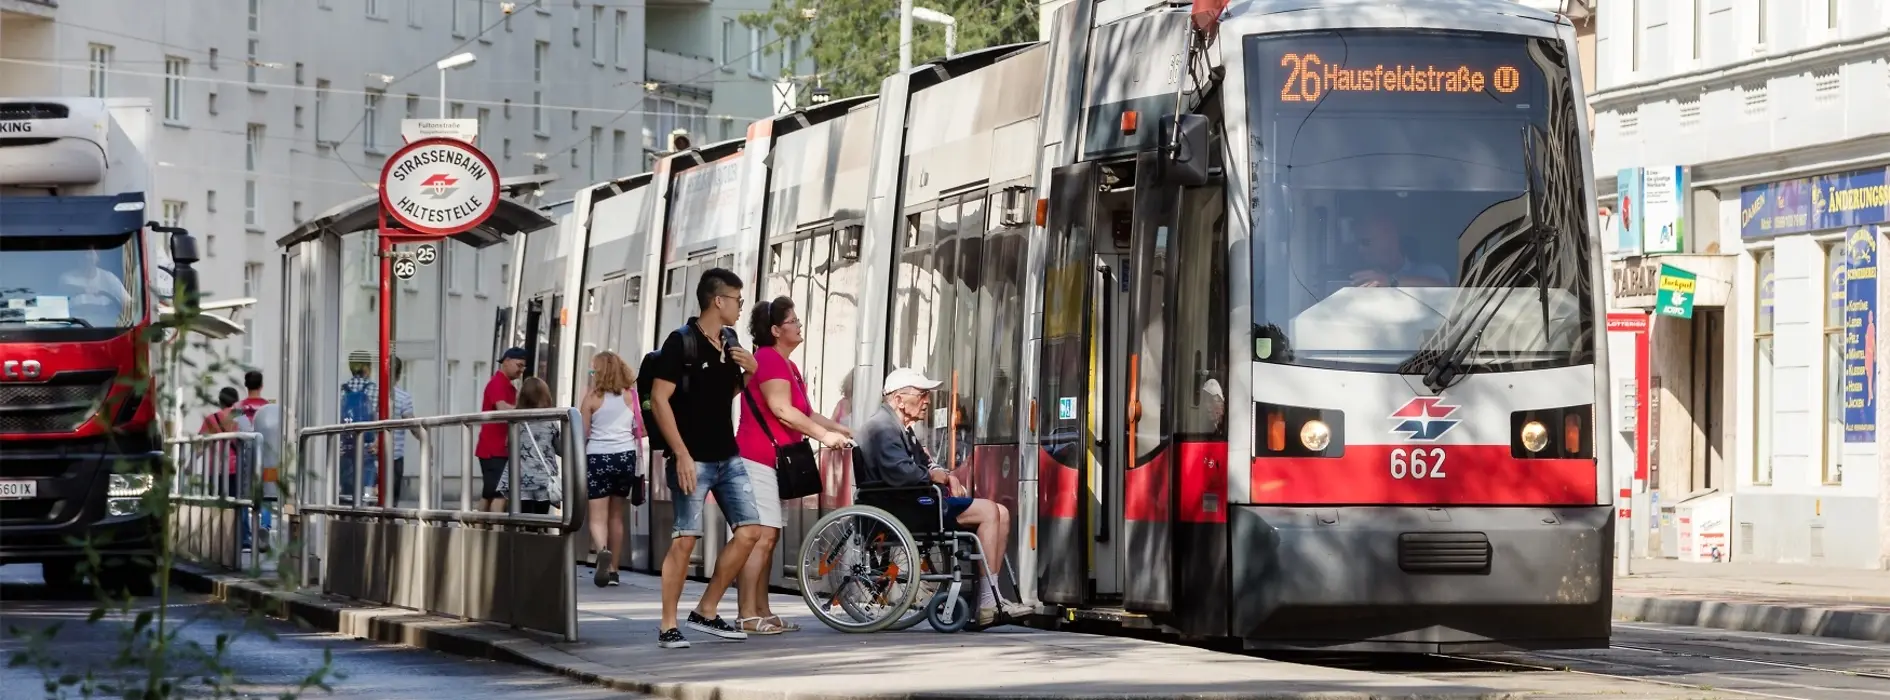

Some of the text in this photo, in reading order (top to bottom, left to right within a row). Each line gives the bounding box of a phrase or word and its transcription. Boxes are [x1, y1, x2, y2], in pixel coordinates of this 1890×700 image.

[1280, 53, 1321, 102] 26
[1323, 64, 1485, 92] Hausfeldstraße
[393, 149, 487, 181] STRASSENBAHN
[397, 195, 483, 223] HALTESTELLE
[396, 262, 414, 276] 26
[417, 248, 435, 261] 25
[1613, 265, 1657, 298] TABAK
[1390, 448, 1446, 479] 662
[20, 483, 31, 495] IX
